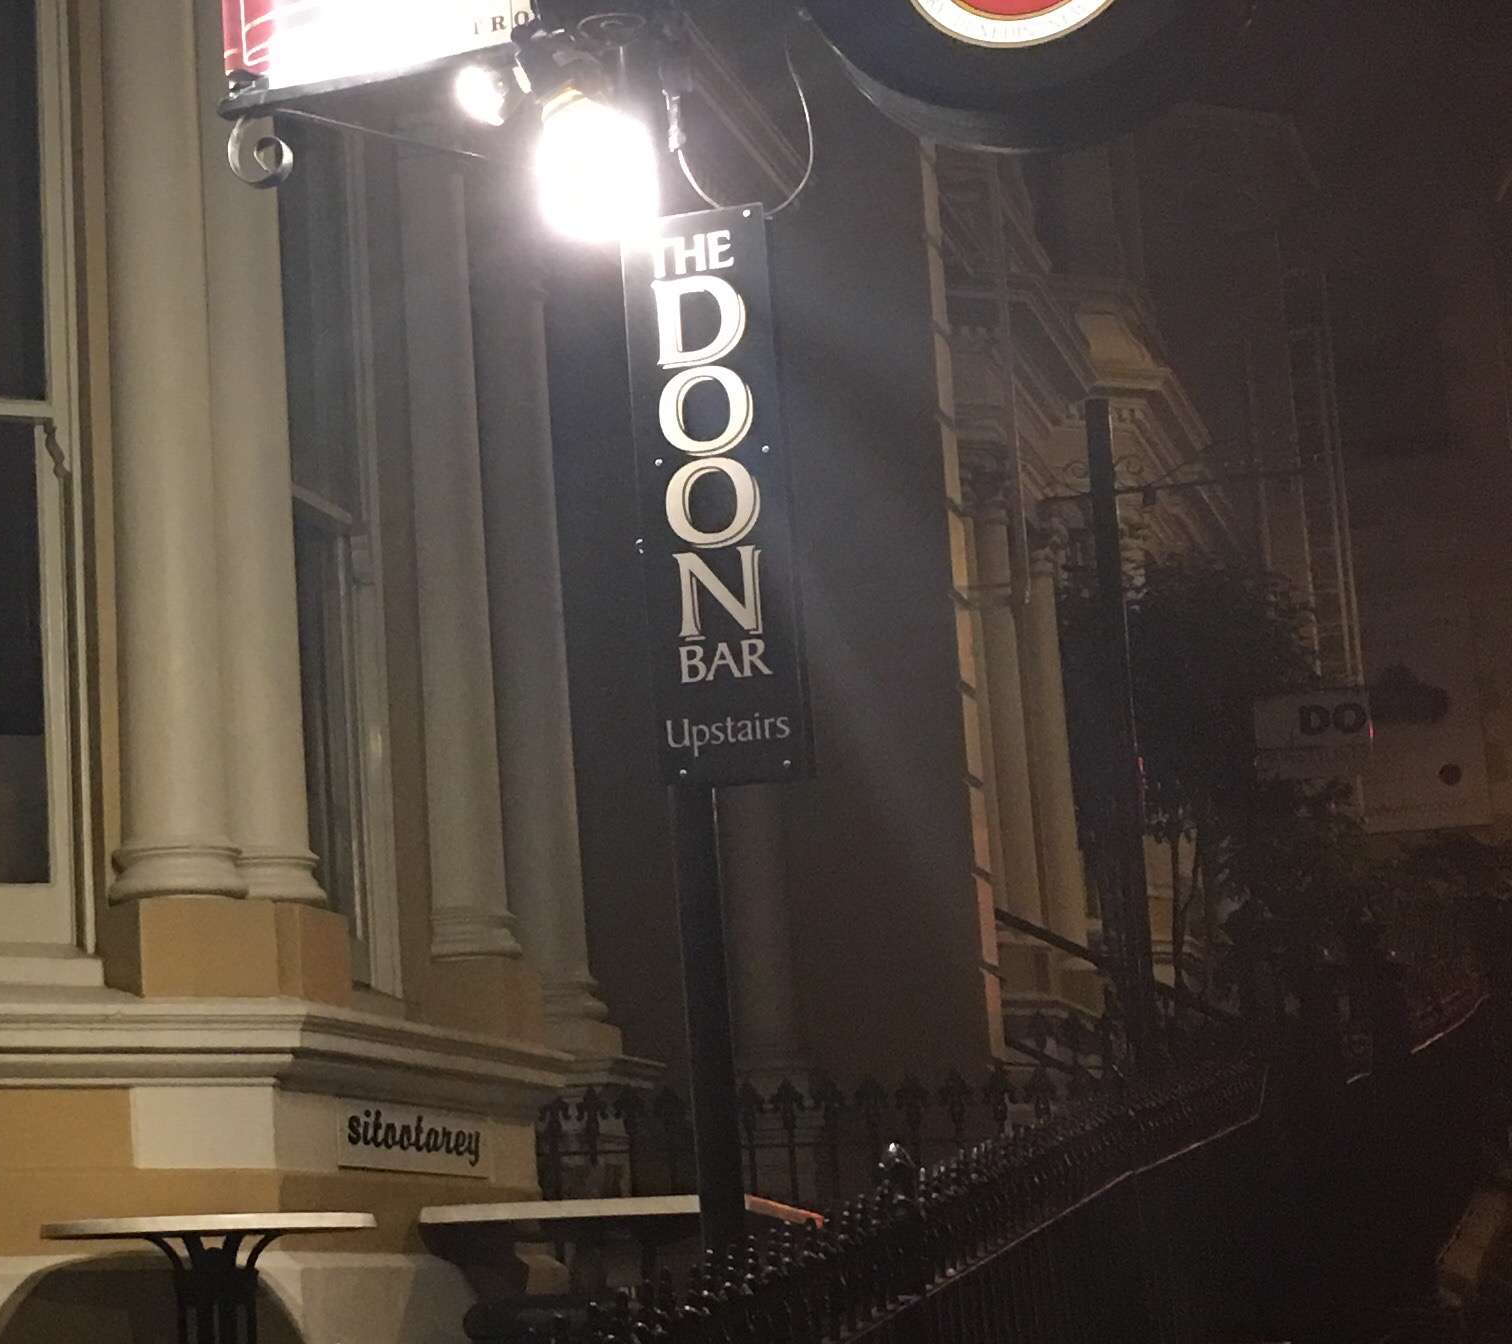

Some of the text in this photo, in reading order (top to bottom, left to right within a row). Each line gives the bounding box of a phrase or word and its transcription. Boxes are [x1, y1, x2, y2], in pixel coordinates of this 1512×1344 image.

[650, 229, 734, 278] THE
[650, 274, 761, 642] DOON
[678, 638, 774, 684] BAR
[665, 710, 791, 757] Upstairs
[347, 1109, 480, 1167] sitootarey
